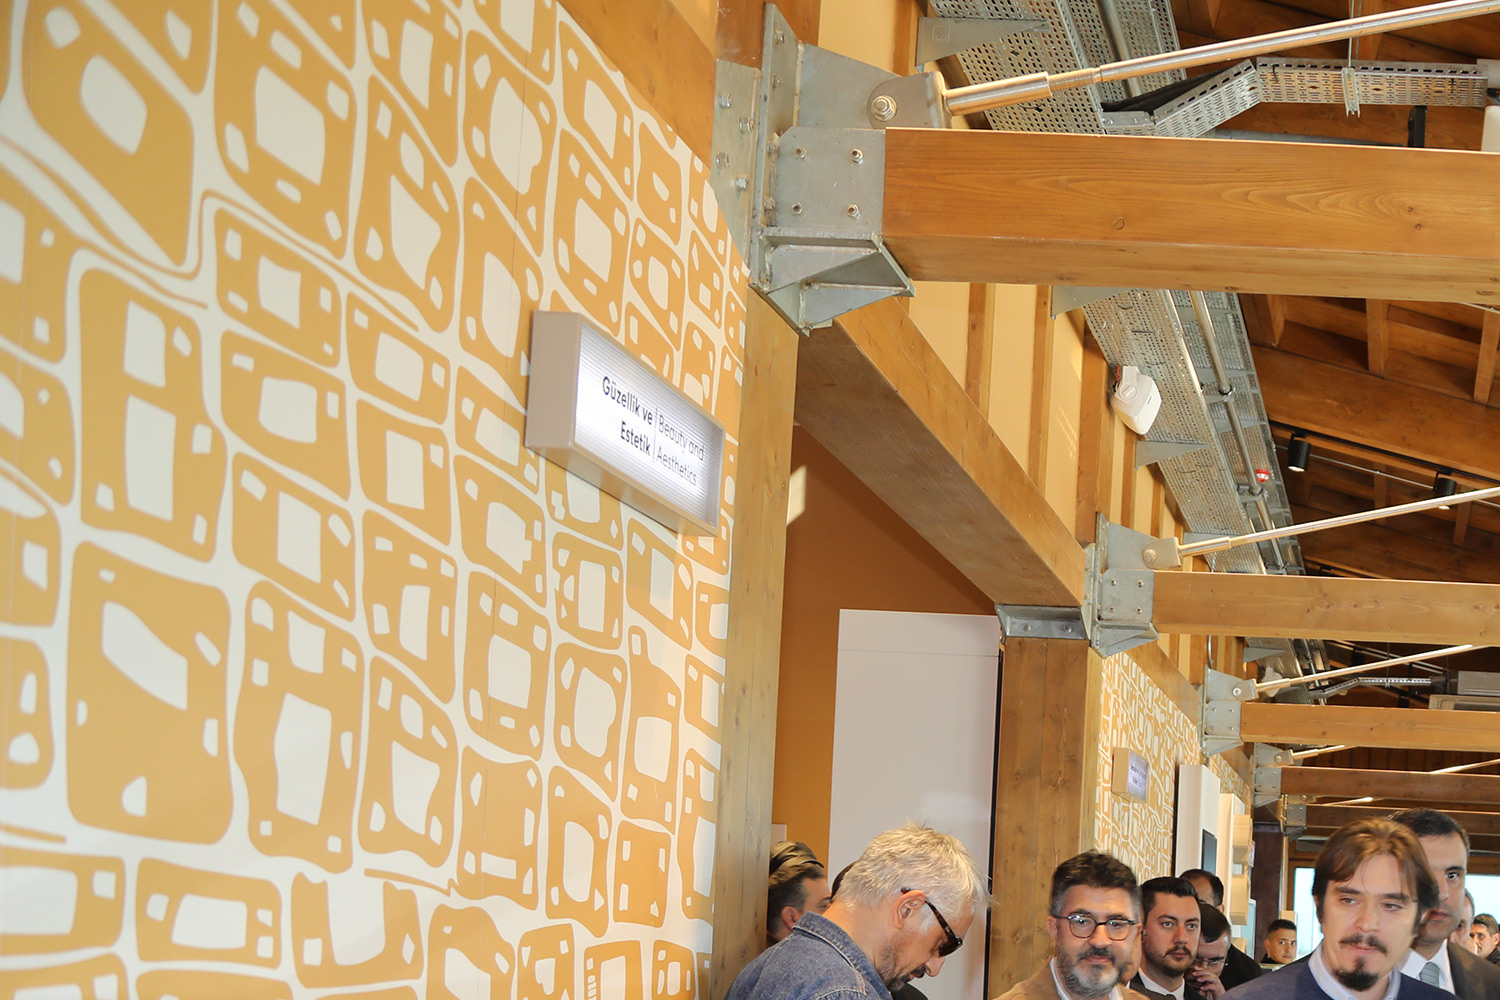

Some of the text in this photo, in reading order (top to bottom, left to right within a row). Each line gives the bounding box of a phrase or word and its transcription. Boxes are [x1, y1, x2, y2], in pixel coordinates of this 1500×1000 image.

[602, 376, 653, 425] Güzellik ve
[620, 421, 651, 455] Estetik
[658, 414, 705, 461] Beauty and
[656, 447, 697, 486] Aesthetics
